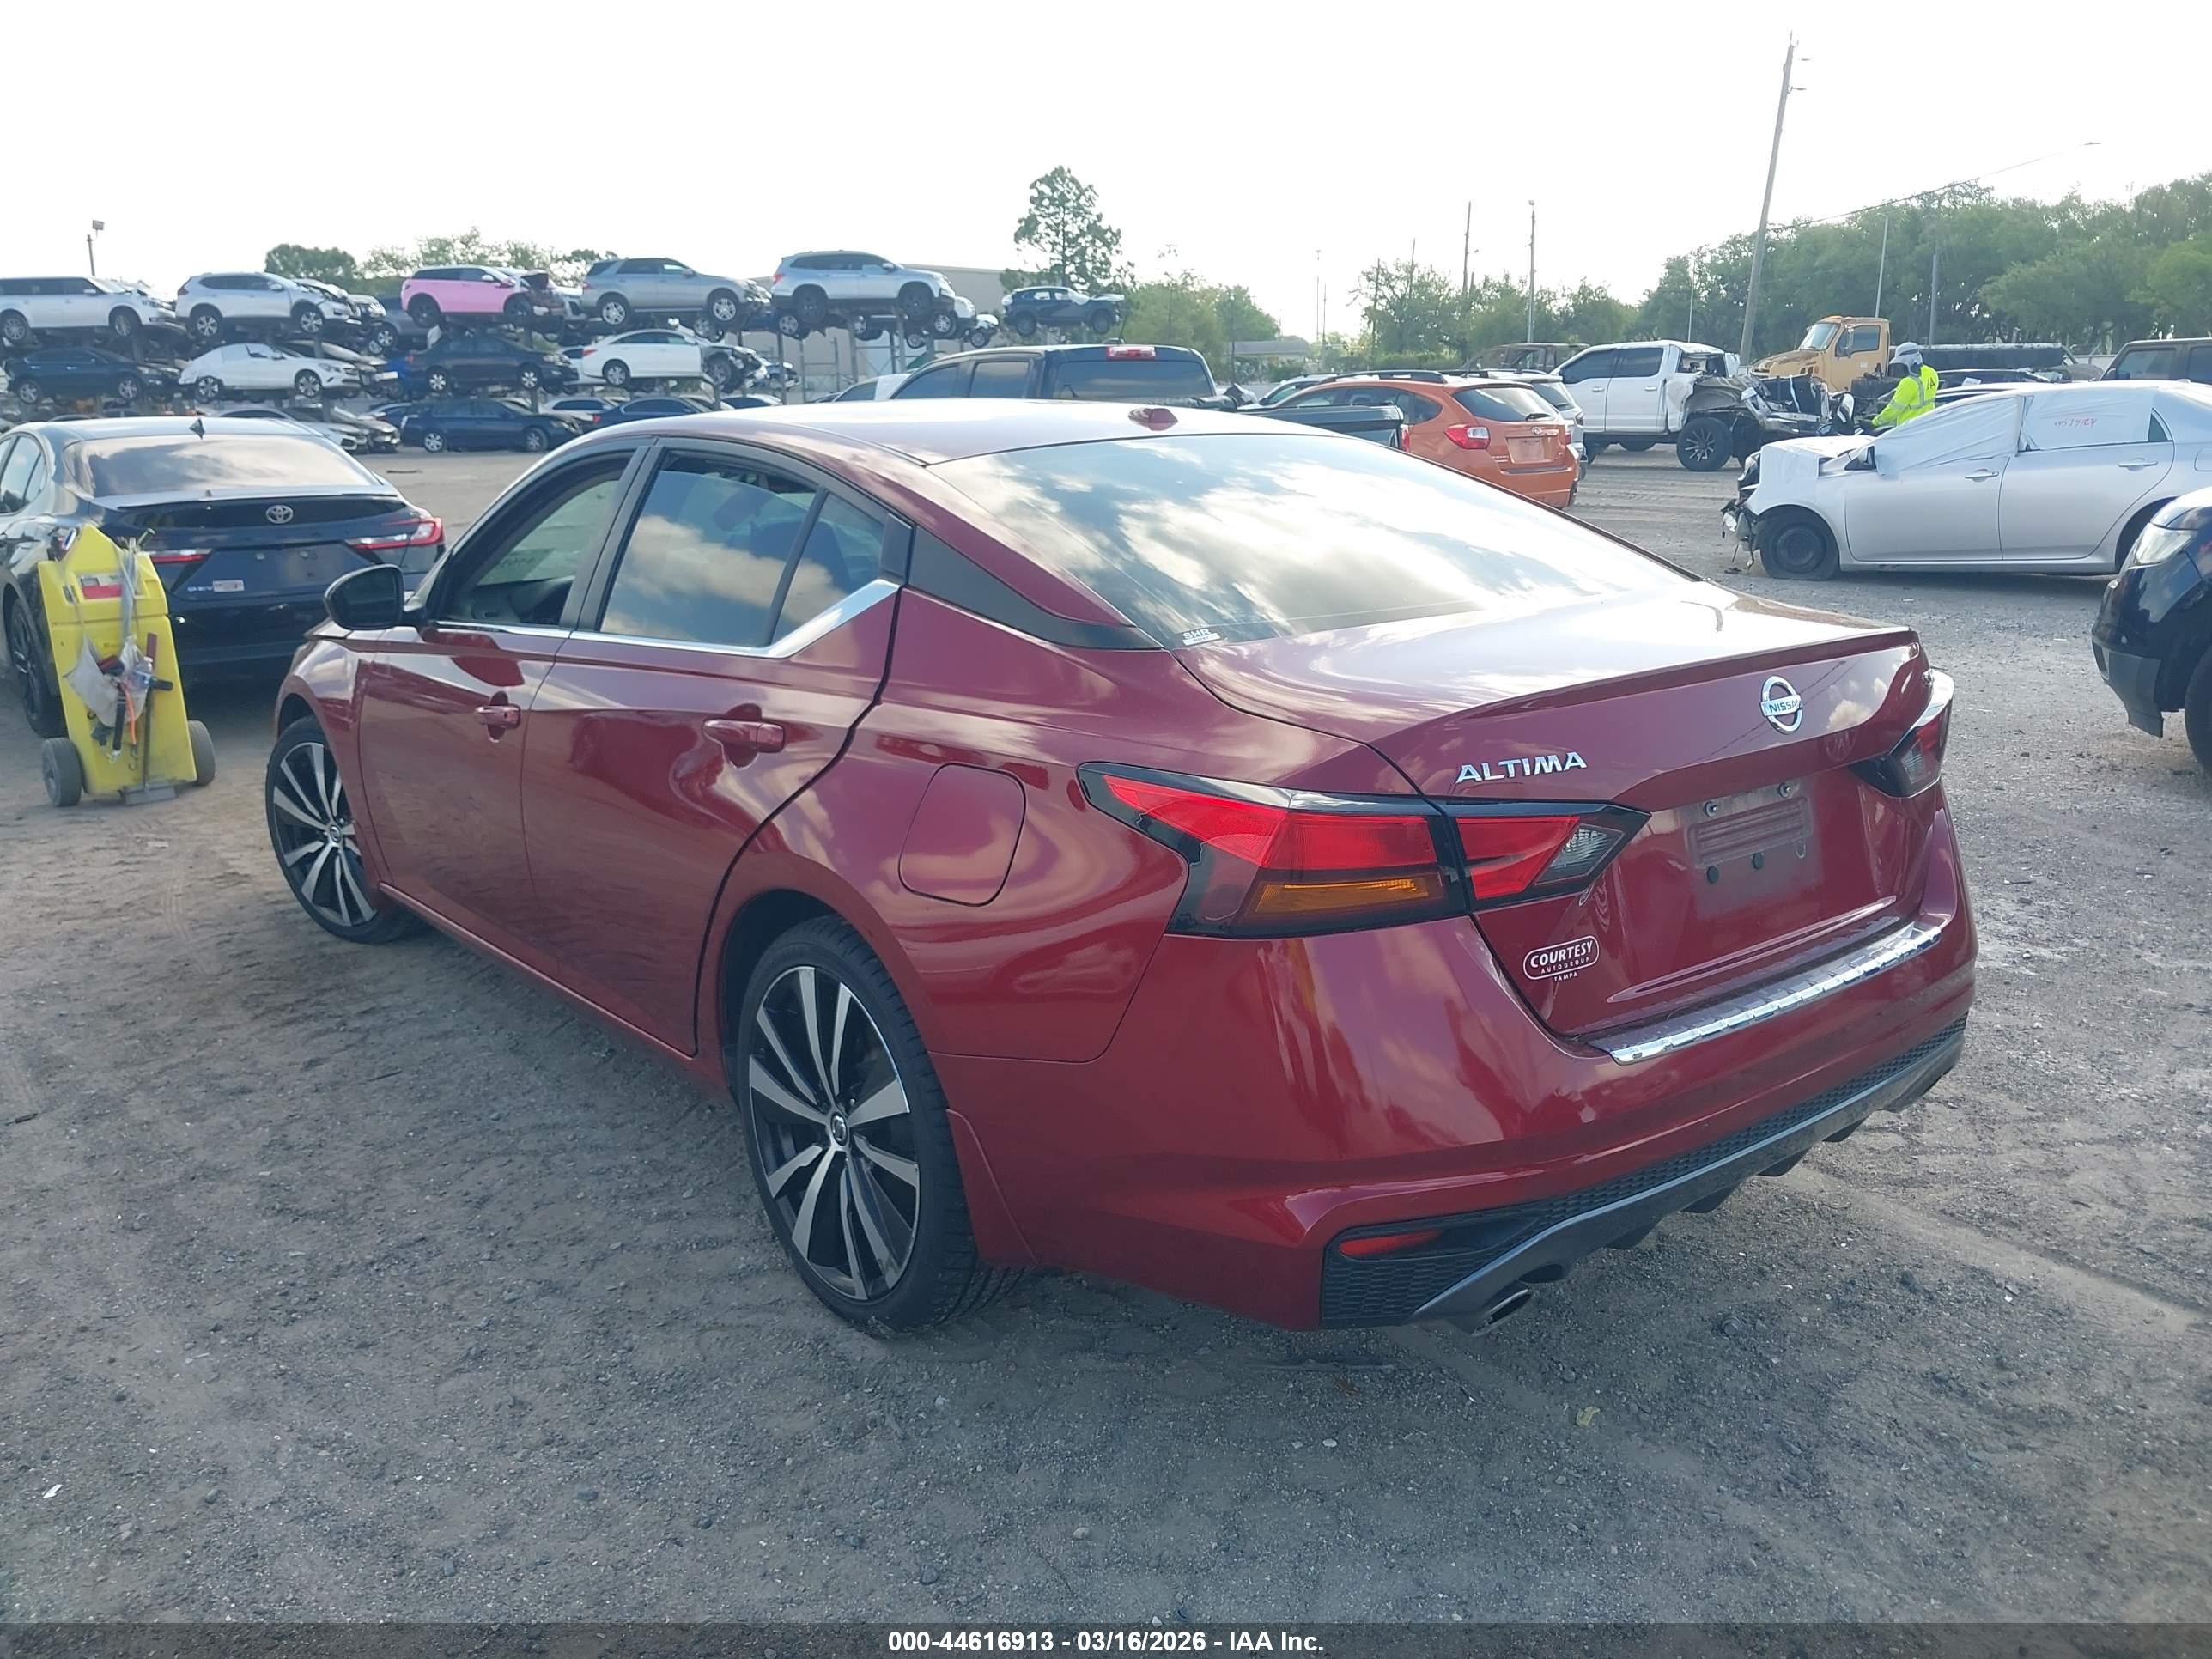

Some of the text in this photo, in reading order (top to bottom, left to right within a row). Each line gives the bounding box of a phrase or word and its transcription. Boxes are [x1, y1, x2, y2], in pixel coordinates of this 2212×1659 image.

[1455, 751, 1587, 783] ALTIMA
[1530, 940, 1593, 968] COURTESY
[1540, 957, 1589, 975] AUTOGROUP
[1553, 971, 1577, 982] TAMPA
